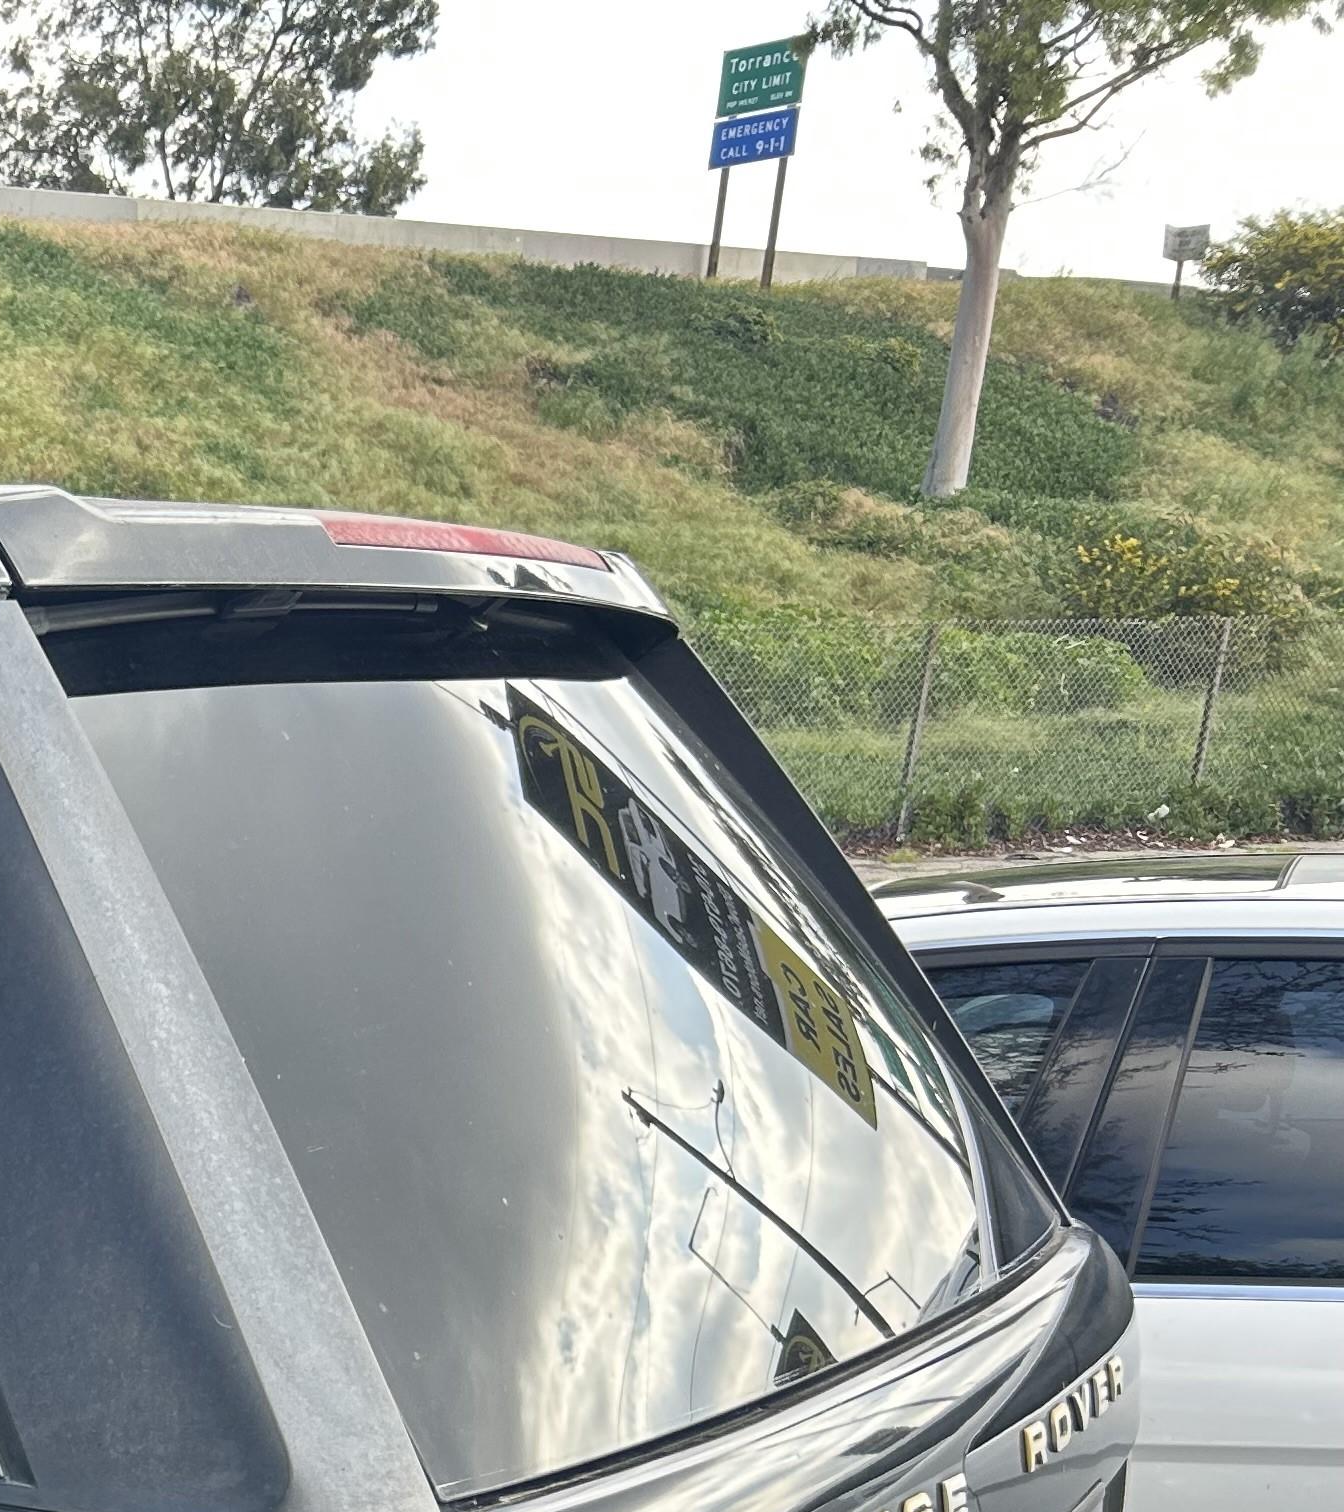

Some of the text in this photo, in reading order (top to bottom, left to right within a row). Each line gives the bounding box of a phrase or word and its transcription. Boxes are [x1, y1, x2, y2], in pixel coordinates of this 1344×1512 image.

[732, 72, 792, 95] CITY LIMIT
[721, 117, 789, 141] EMERGENCY
[720, 136, 785, 160] CALL 9-1-1
[1022, 1354, 1124, 1474] ROVER
